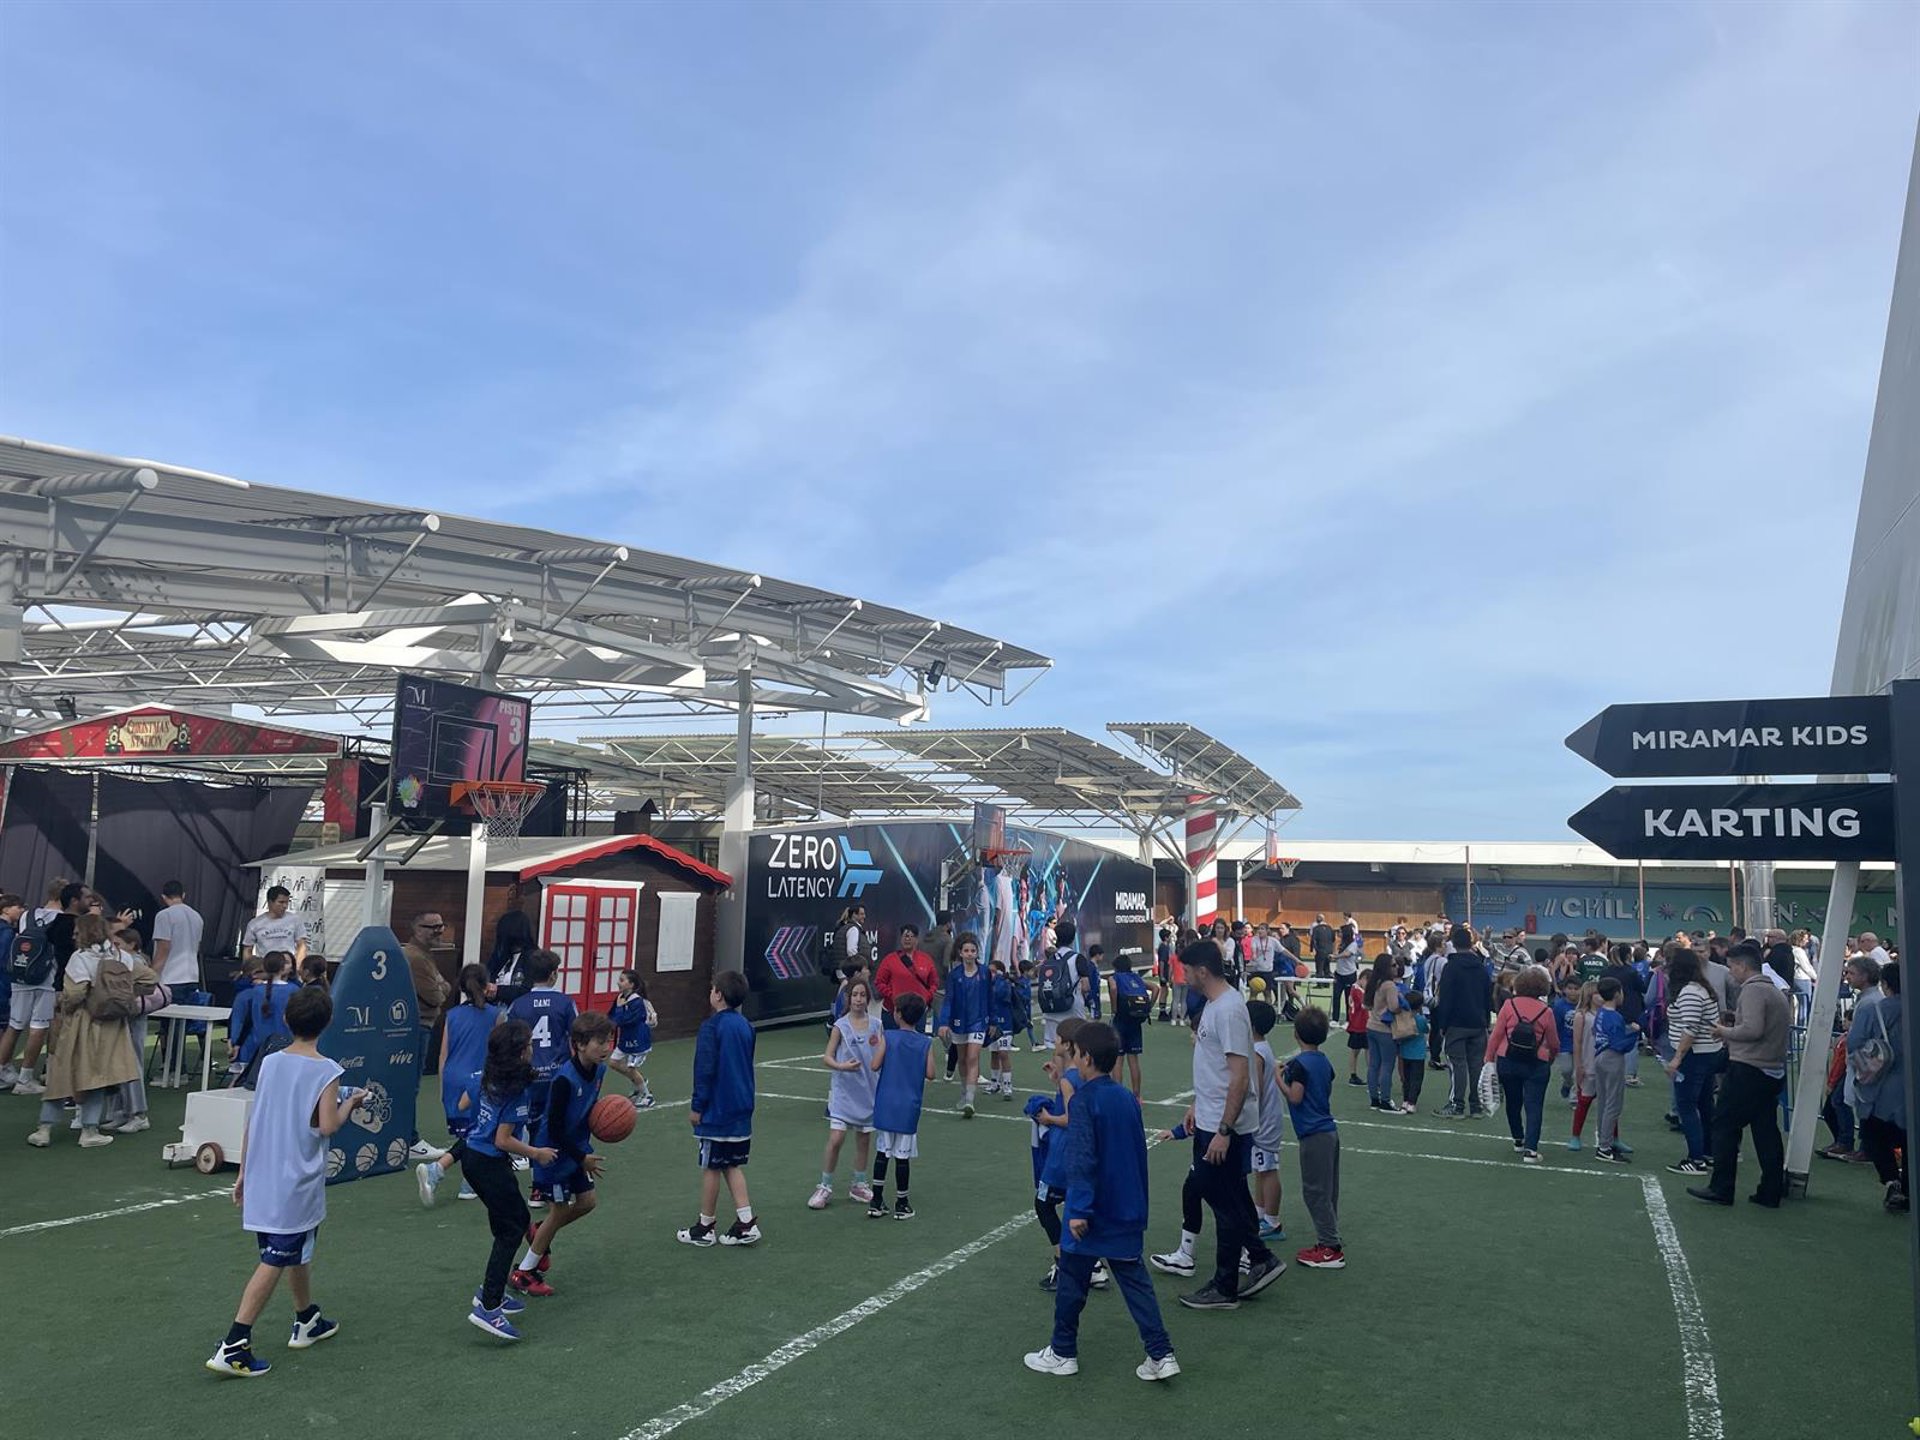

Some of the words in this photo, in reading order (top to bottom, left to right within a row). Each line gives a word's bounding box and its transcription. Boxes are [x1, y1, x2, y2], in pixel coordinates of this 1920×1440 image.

[500, 701, 522, 717] PISTA
[126, 720, 170, 735] CHRISTMAS
[509, 717, 521, 745] 3
[1632, 727, 1784, 750] MIRAMAR
[1792, 725, 1868, 746] KIDS
[131, 734, 163, 748] STATION
[1644, 807, 1860, 838] KARTING
[767, 833, 837, 871] ZERO
[767, 876, 835, 899] LATENCY
[1115, 890, 1147, 911] MIRAMAR
[371, 950, 388, 981] 3
[533, 998, 552, 1008] DANI
[531, 1015, 552, 1048] 4
[1254, 1151, 1265, 1166] 3
